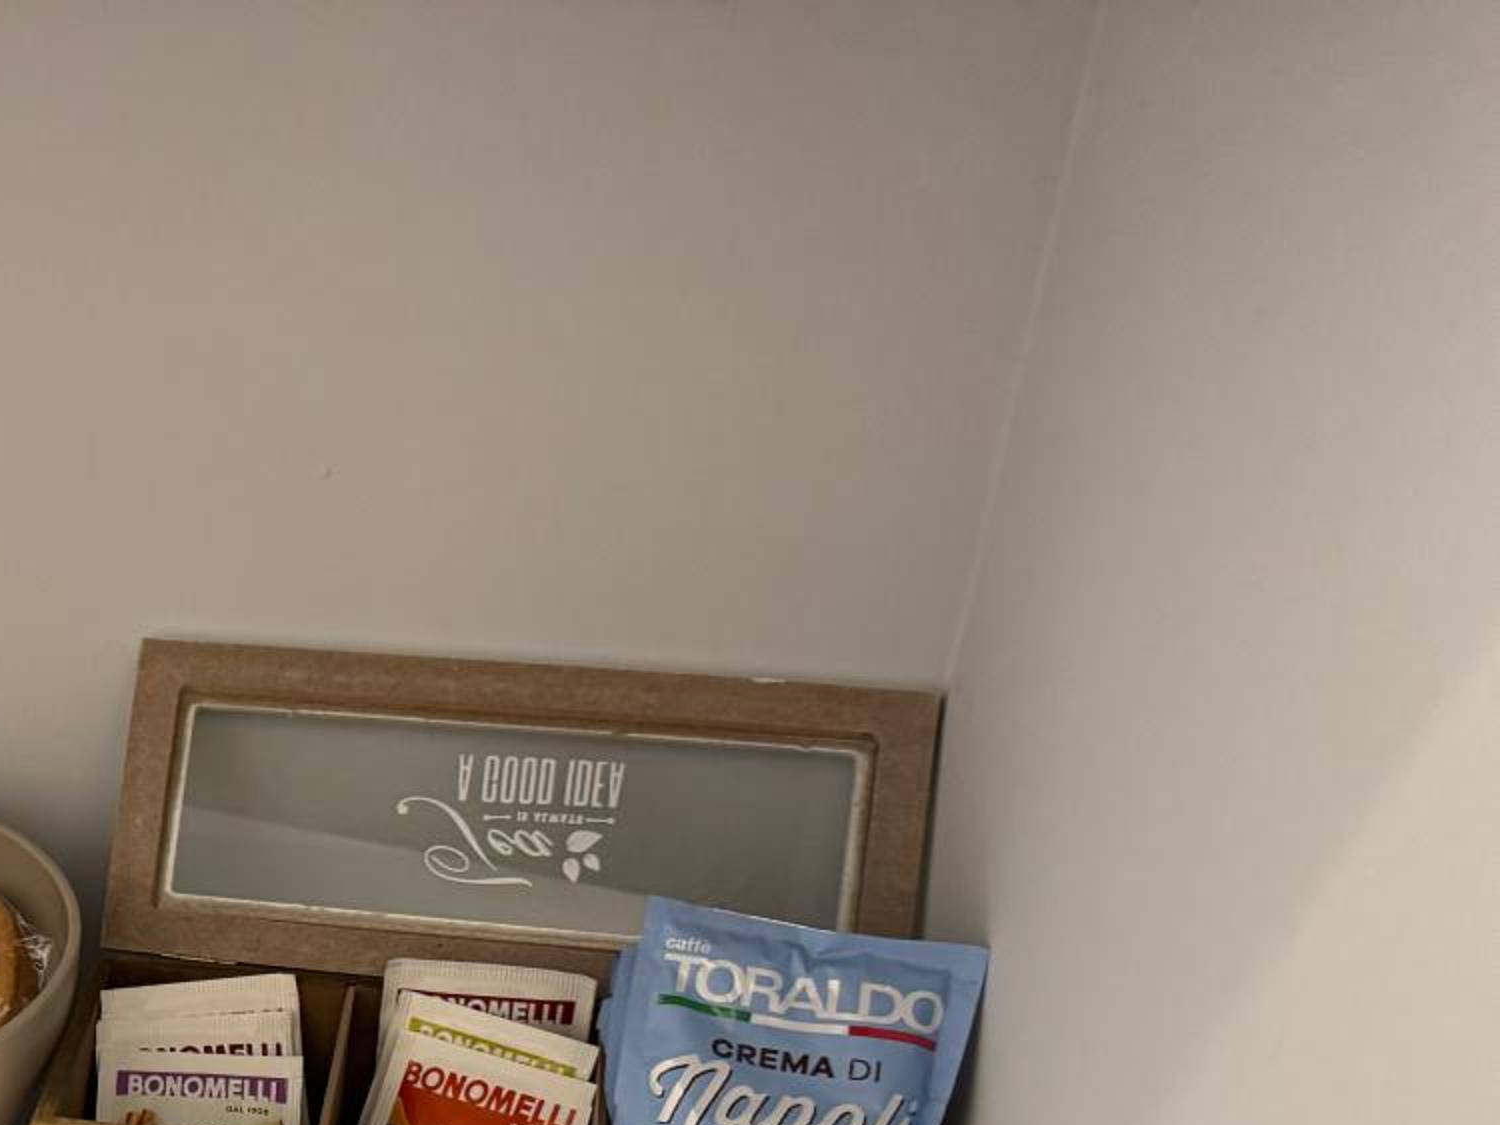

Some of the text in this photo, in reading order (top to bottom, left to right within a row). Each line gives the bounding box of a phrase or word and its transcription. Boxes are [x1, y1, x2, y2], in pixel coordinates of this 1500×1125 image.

[663, 953, 944, 1034] TORALDO
[711, 1038, 882, 1083] CREMA DI
[127, 1073, 277, 1104] BONOMELLI
